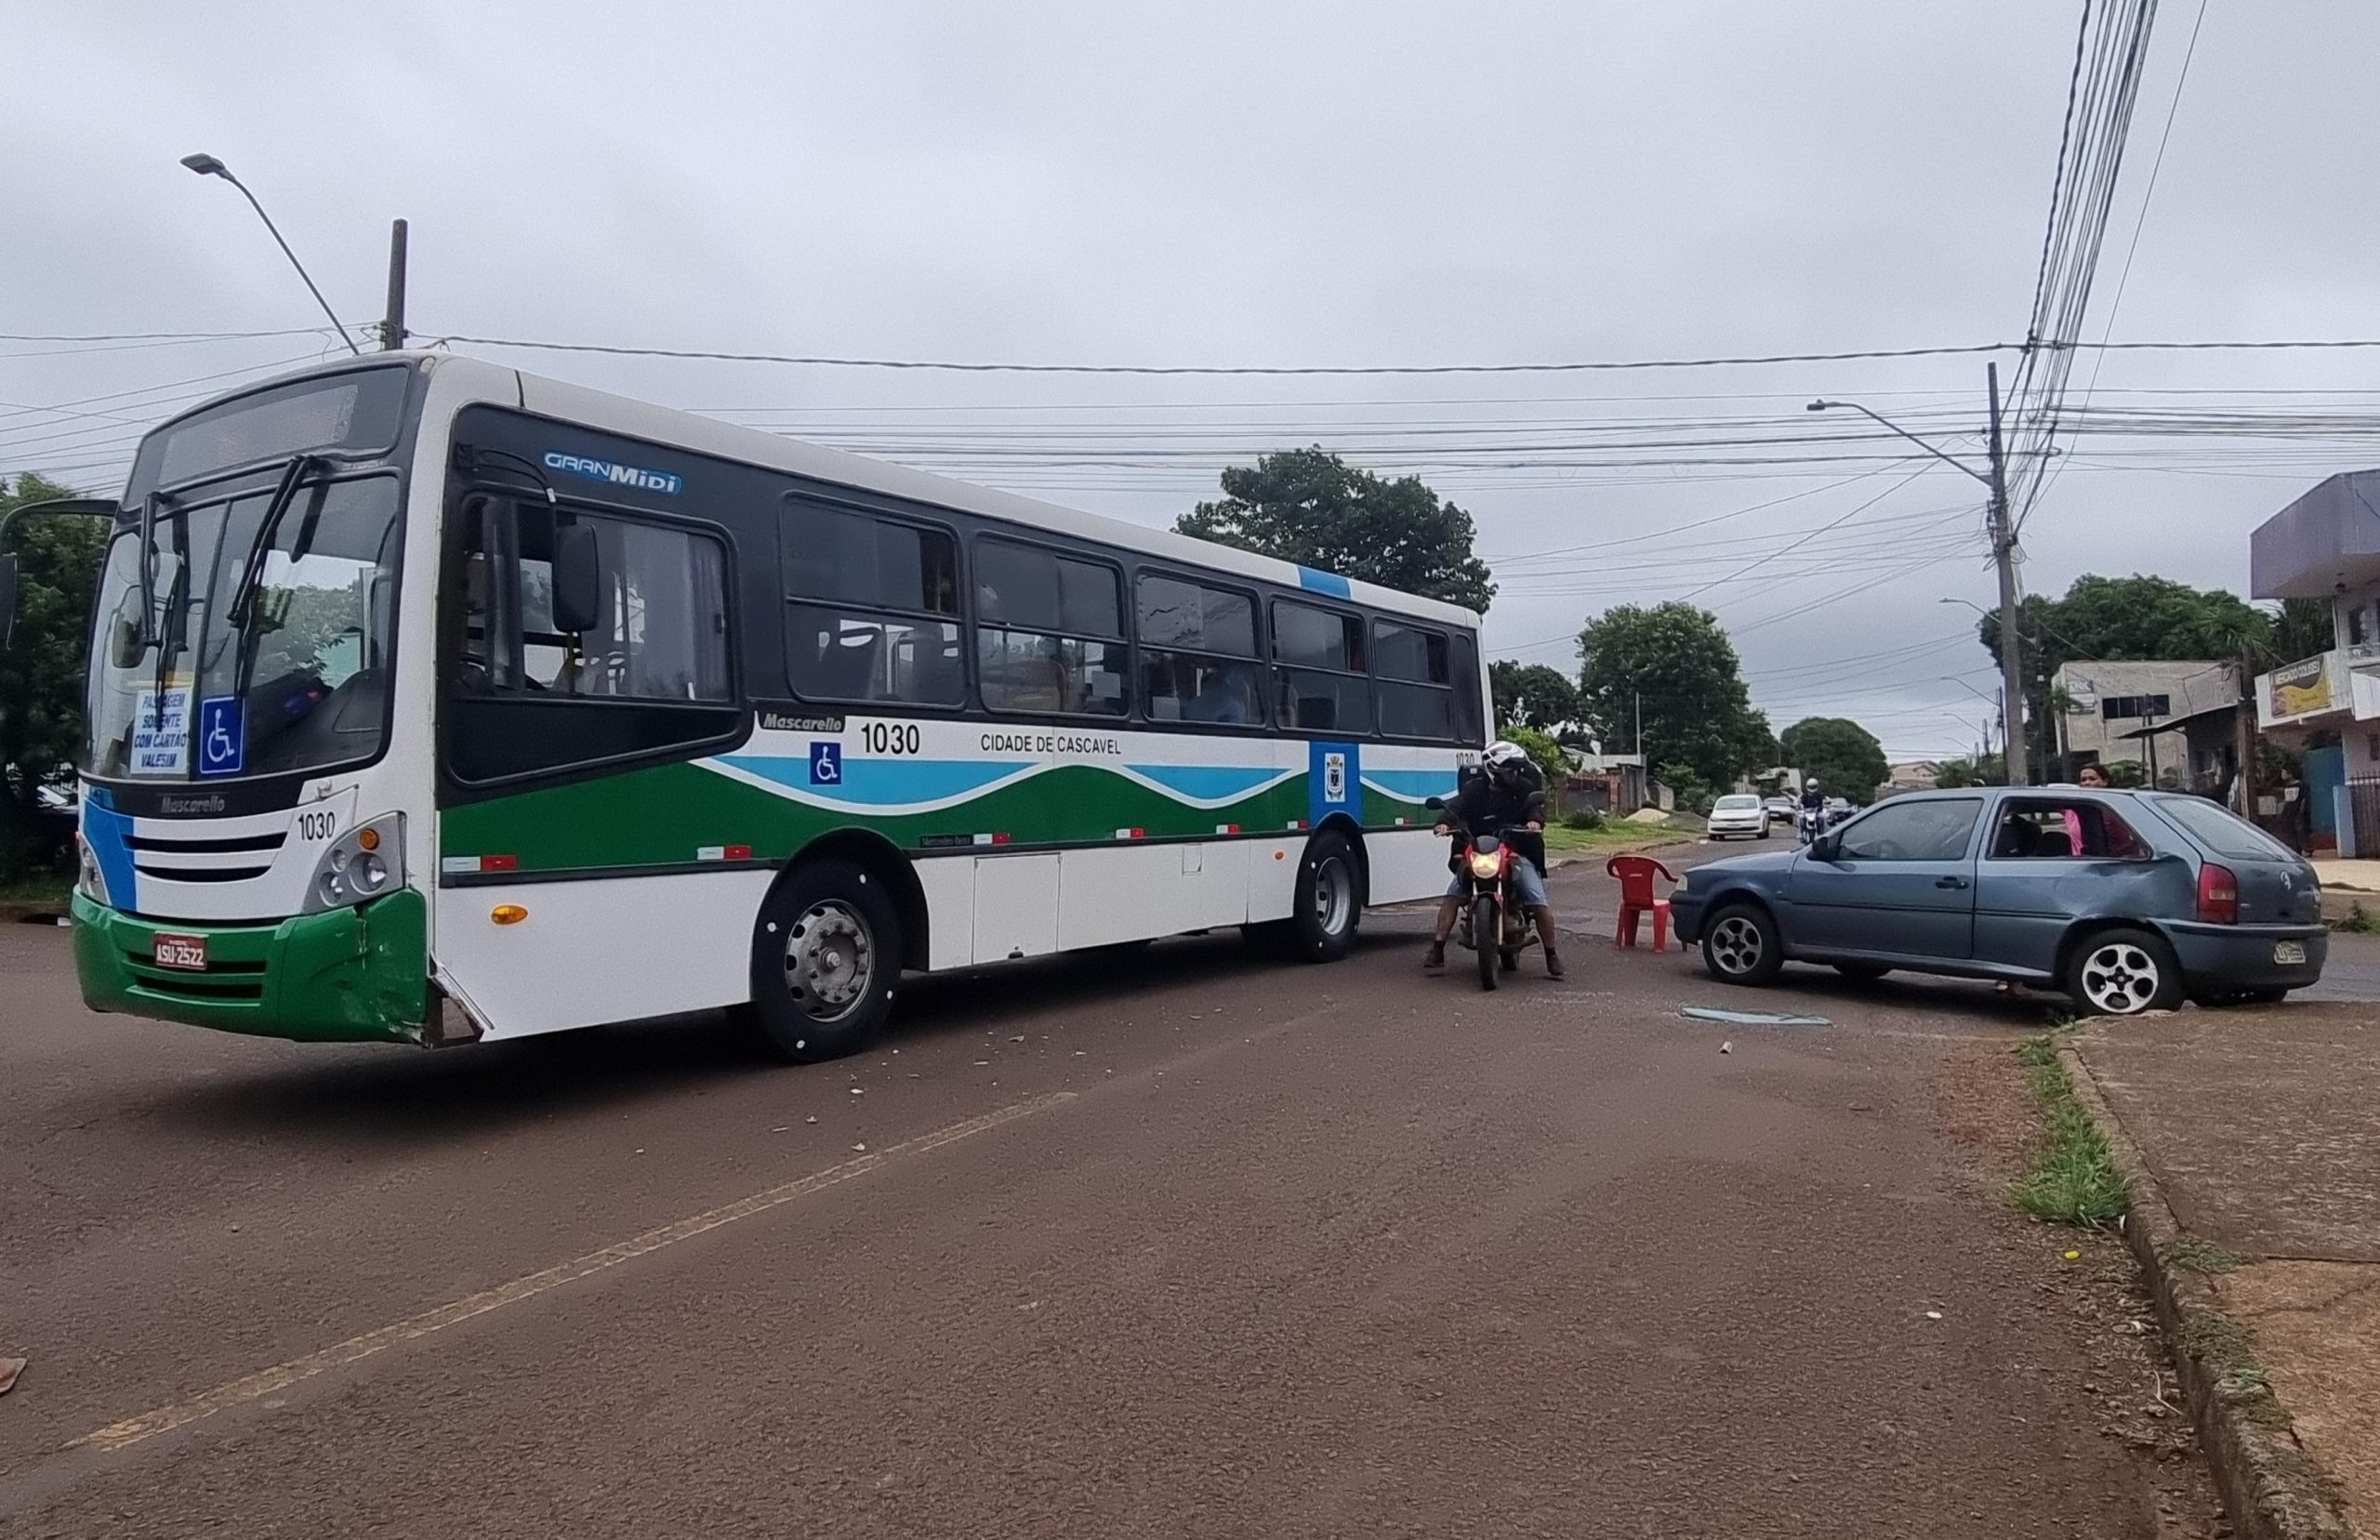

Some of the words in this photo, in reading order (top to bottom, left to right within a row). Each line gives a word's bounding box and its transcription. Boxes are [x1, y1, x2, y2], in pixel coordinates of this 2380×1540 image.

[763, 713, 842, 731] Mascarello
[134, 734, 152, 748] COM
[861, 722, 920, 755] 1030
[981, 734, 1032, 752] CIDADE
[1037, 736, 1053, 752] DE
[1057, 736, 1121, 755] CASCAVEL
[161, 795, 225, 814] Mascarello
[298, 811, 336, 841] 1030
